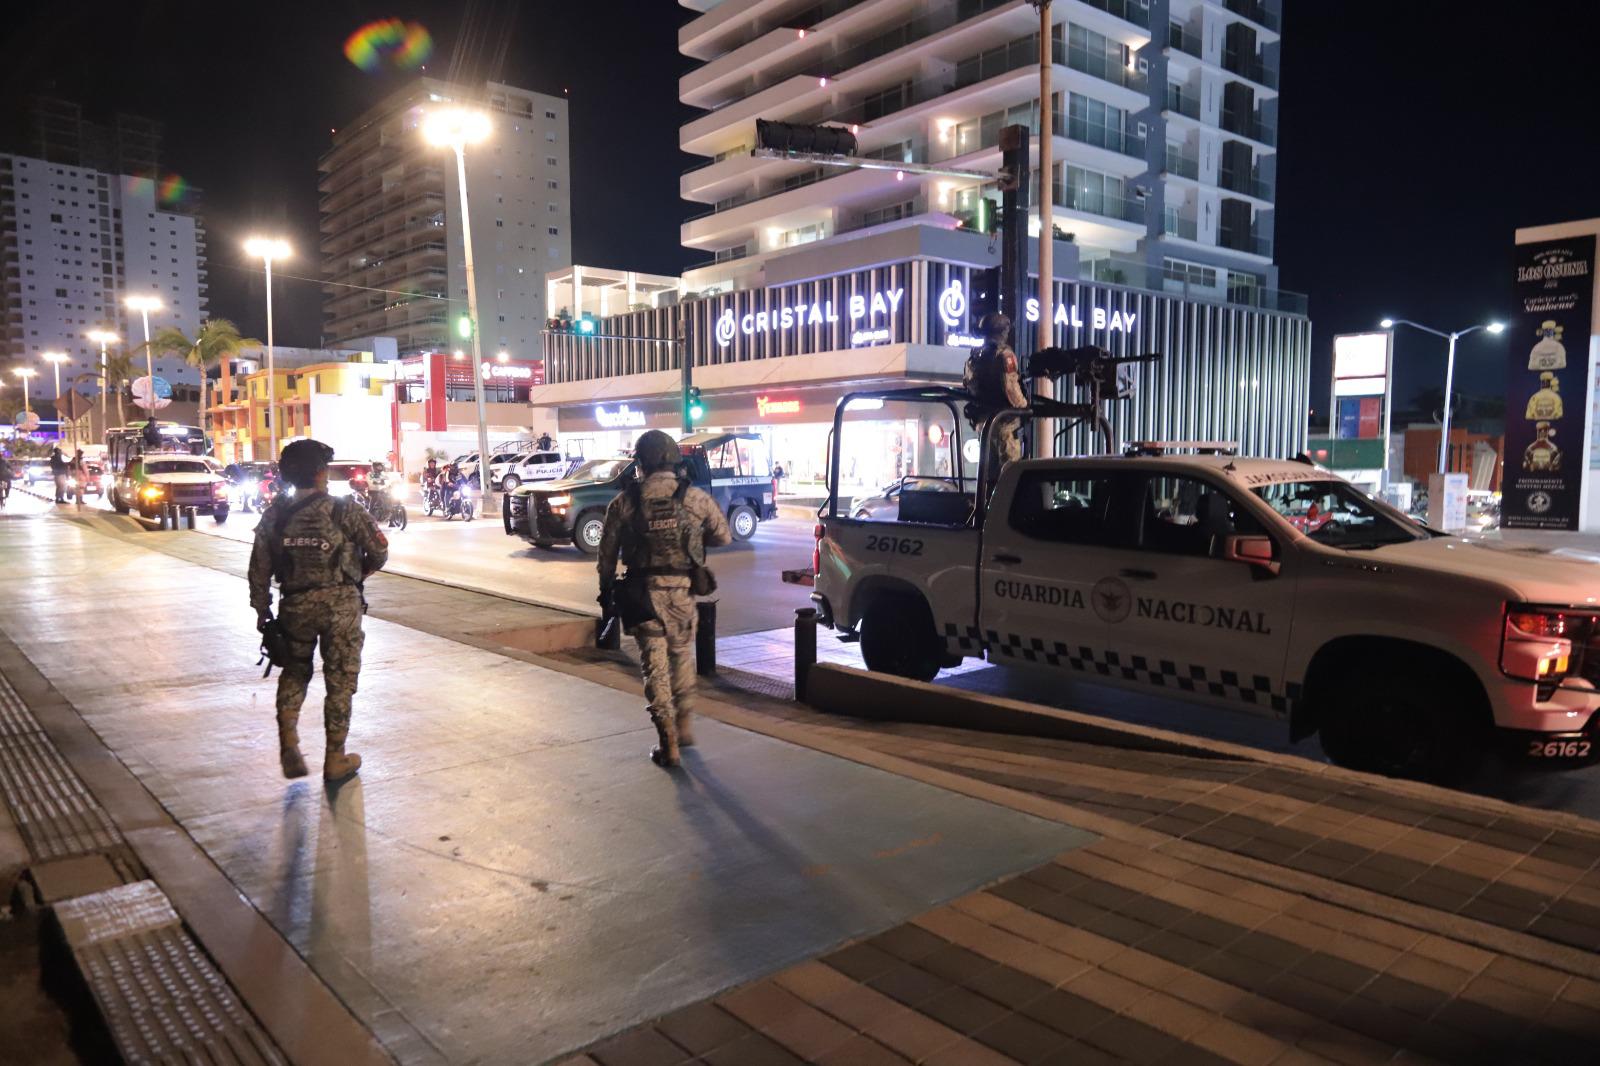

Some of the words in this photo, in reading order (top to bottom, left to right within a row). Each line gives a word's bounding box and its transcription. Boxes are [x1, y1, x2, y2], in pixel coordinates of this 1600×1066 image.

[1517, 265, 1543, 282] LOS
[1543, 260, 1589, 280] OSUNA
[742, 300, 839, 334] CRISTAL
[850, 288, 904, 321] BAY
[1094, 307, 1136, 333] BAY
[866, 535, 924, 556] 26162
[994, 579, 1085, 609] GUARDIA
[1136, 597, 1271, 635] NACIONAL
[1528, 741, 1591, 757] 26162
